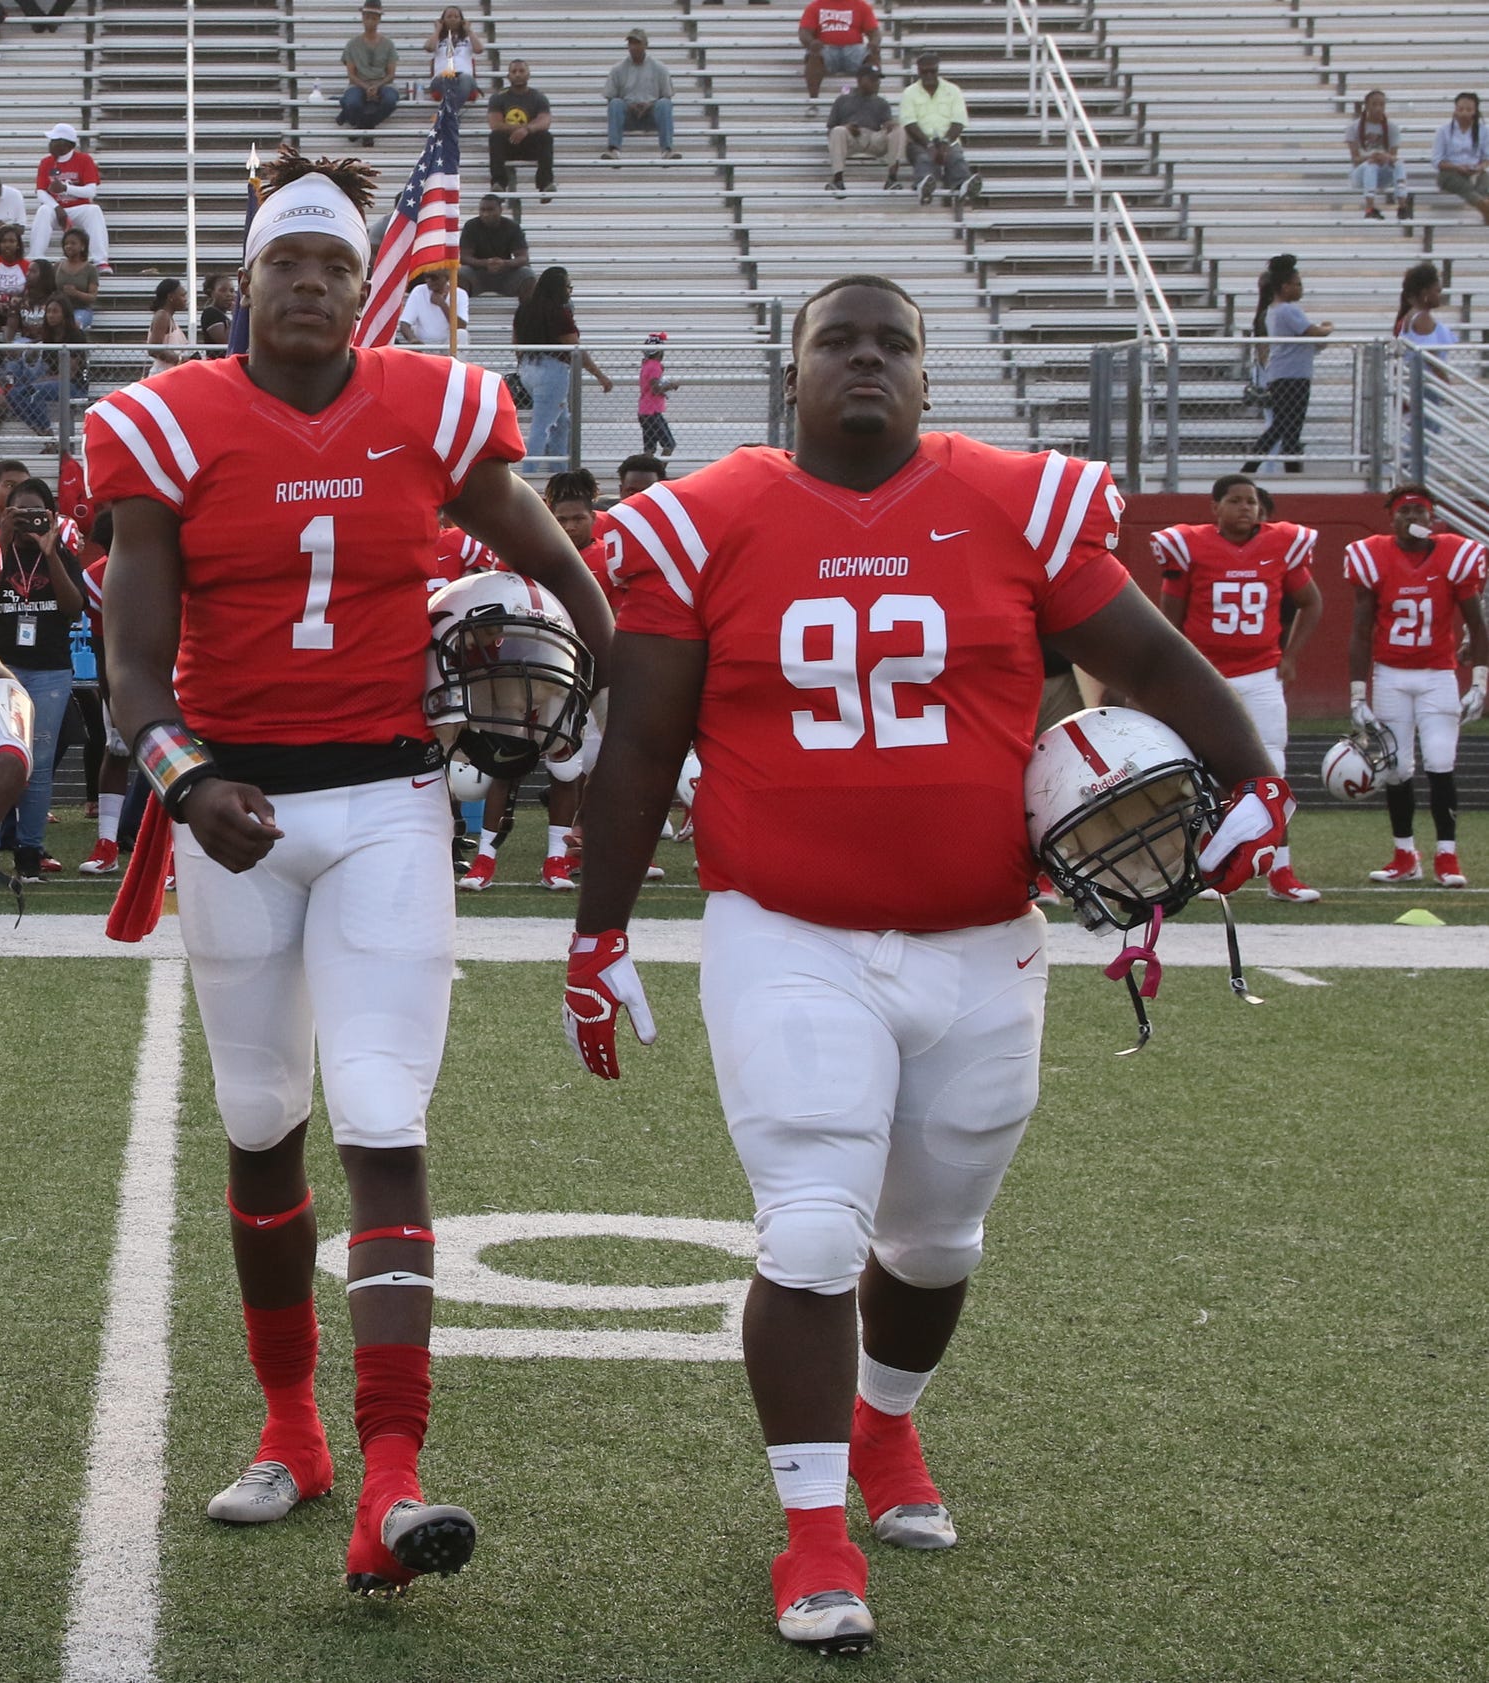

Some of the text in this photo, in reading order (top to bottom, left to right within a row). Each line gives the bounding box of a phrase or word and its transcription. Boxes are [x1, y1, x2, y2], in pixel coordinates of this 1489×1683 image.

[278, 207, 330, 220] BATTLE
[275, 477, 363, 503] RICHWOOD
[292, 515, 335, 650] 1
[818, 557, 909, 579] RICHWOOD
[1212, 582, 1268, 635] 59
[1389, 598, 1432, 647] 21
[779, 593, 949, 750] 92
[1089, 767, 1129, 795] Riddell
